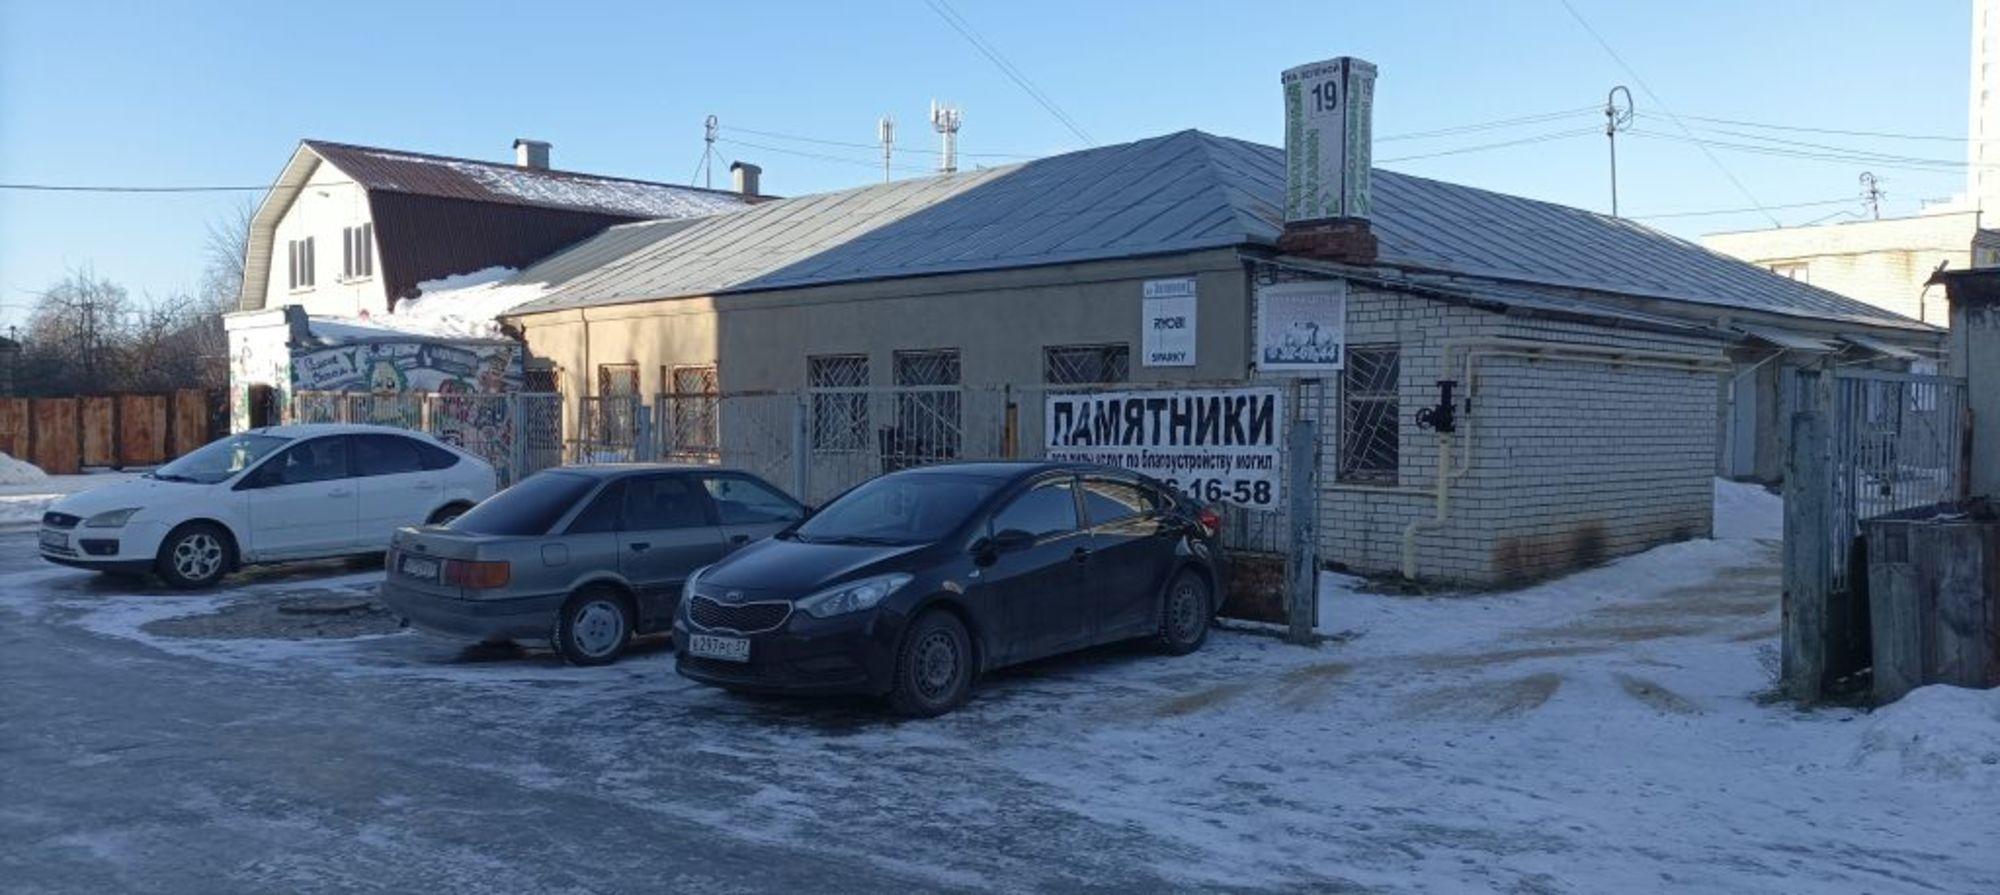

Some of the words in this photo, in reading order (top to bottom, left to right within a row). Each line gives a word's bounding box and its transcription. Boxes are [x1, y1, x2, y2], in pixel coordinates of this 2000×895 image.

[1312, 80, 1337, 112] 19
[1153, 316, 1186, 329] RYOBI
[1151, 352, 1186, 363] SPARKY
[1052, 395, 1274, 446] ПАМЯТНИКИ
[1126, 454, 1139, 468] по
[1142, 449, 1232, 475] благоустройству
[1236, 453, 1273, 470] могил
